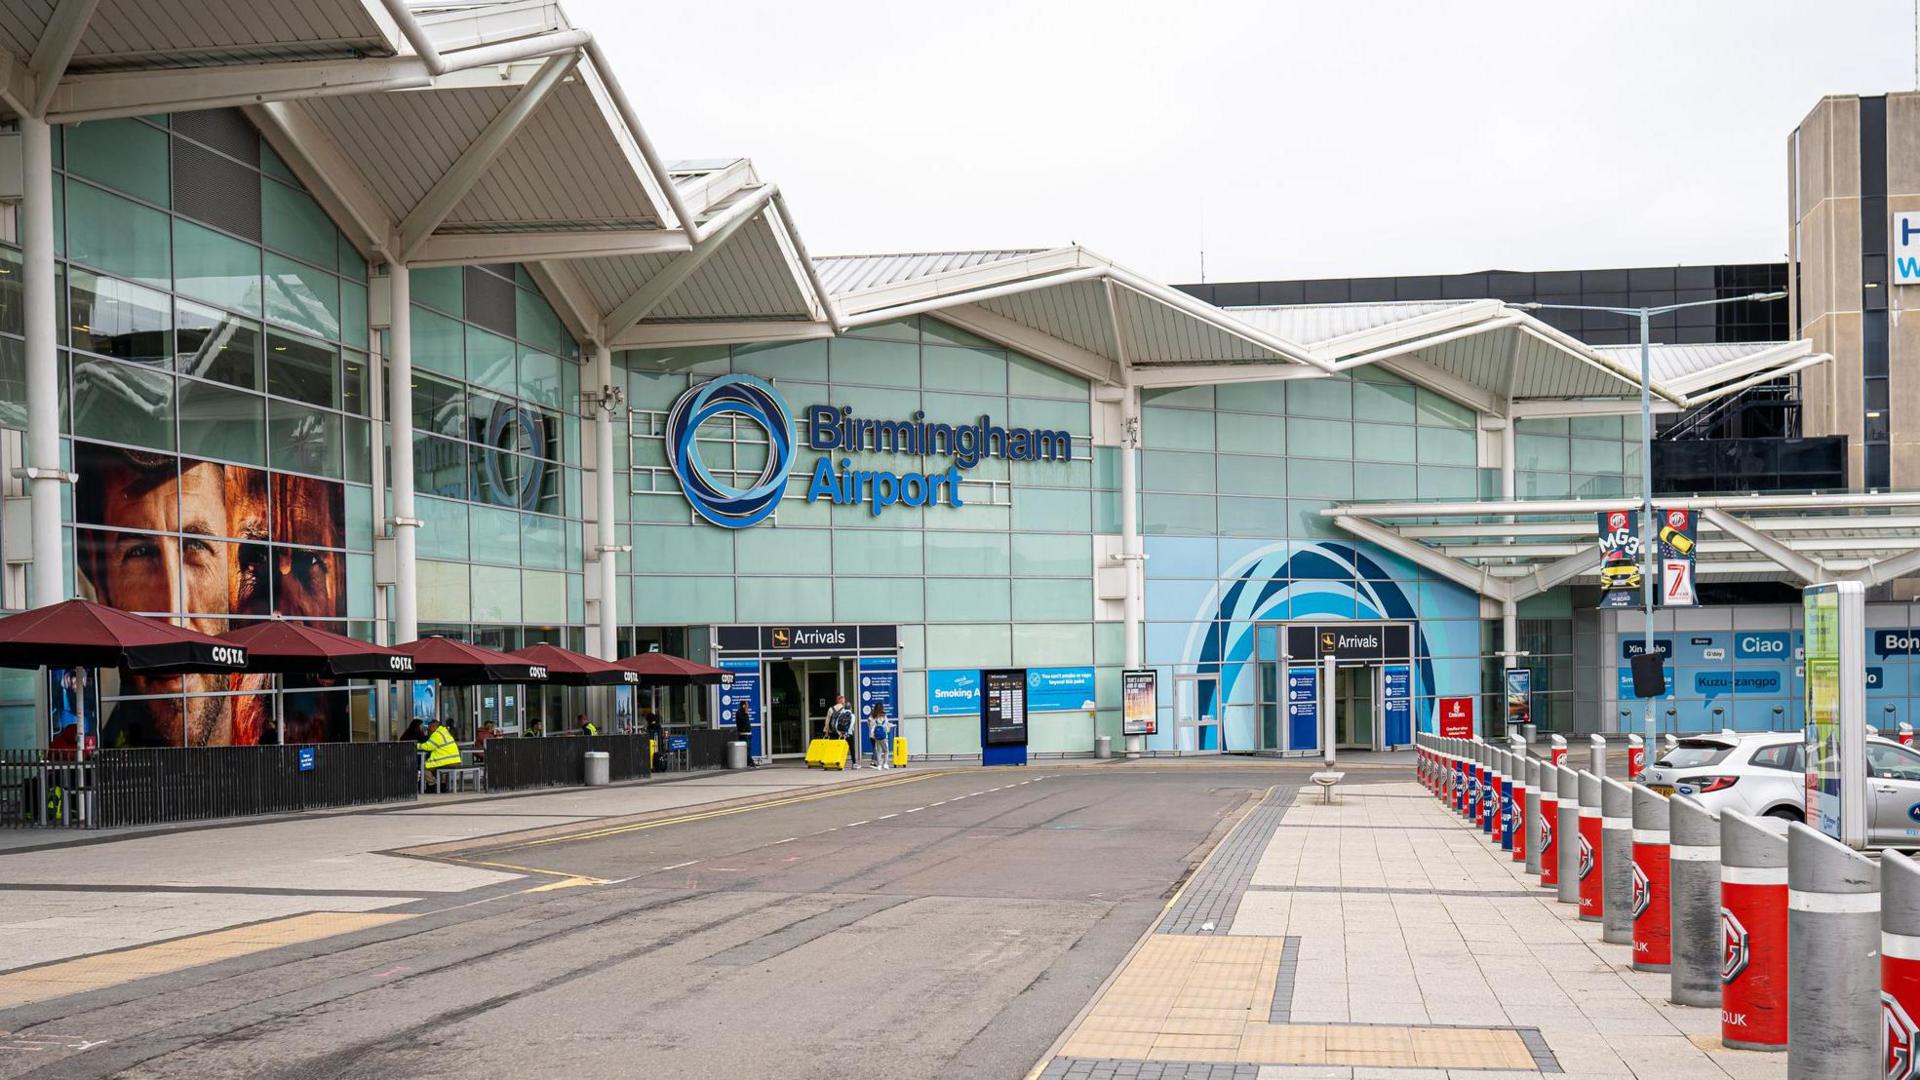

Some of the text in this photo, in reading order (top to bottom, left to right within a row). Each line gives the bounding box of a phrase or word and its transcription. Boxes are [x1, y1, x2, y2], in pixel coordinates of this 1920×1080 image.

[809, 404, 1072, 470] Birmingham
[807, 458, 964, 517] Airport
[1598, 527, 1640, 556] MG3
[1667, 563, 1686, 597] 7
[794, 629, 846, 644] Arrivals
[1338, 634, 1379, 648] Arrivals
[1741, 636, 1783, 653] Ciao
[1885, 634, 1920, 652] Bon
[212, 646, 244, 665] COSTA
[1628, 644, 1643, 653] Xin
[390, 655, 413, 671] COSTA
[529, 665, 547, 679] COSTA
[934, 688, 973, 699] Smoking
